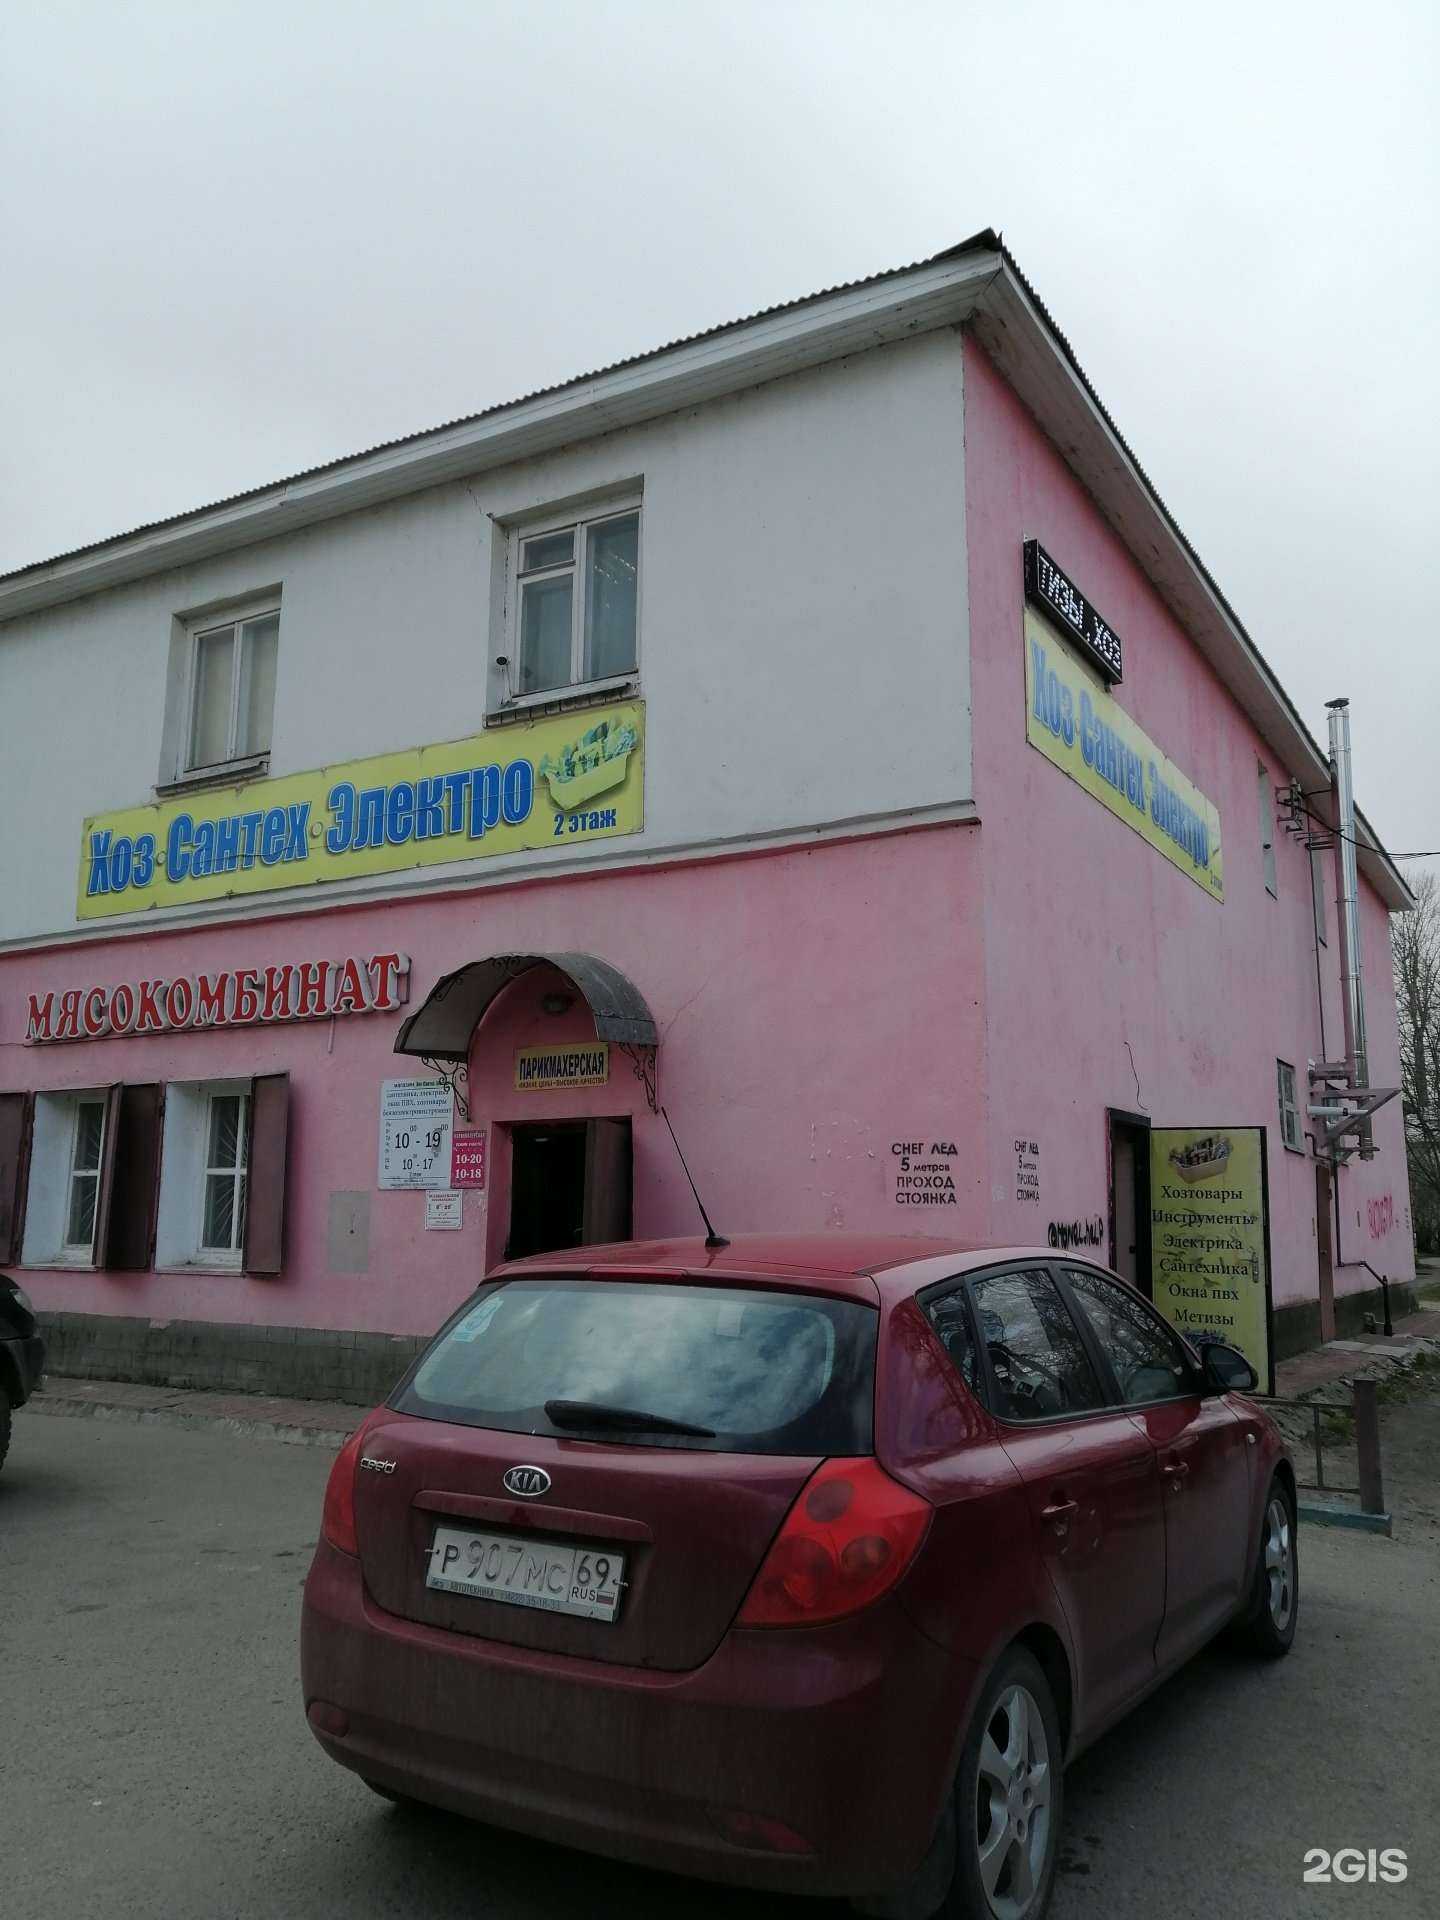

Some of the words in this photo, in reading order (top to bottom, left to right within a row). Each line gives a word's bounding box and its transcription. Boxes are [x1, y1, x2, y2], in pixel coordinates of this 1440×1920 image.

[1031, 638, 1075, 748] Хоз
[1079, 688, 1146, 815] Сантех
[86, 829, 157, 897] Хоз
[166, 801, 312, 884] Сантех
[325, 758, 534, 855] Электро
[553, 814, 566, 836] 2
[569, 809, 617, 833] этаж
[25, 953, 404, 1042] МЯСОКОМБИНАТ
[519, 1051, 605, 1081] ПАРИКМАХЕРСКАЯ
[395, 1132, 410, 1149] 10
[425, 1131, 441, 1149] 19
[891, 1142, 924, 1155] СНЕГ
[930, 1142, 959, 1156] ЛЕД
[402, 1158, 413, 1170] 10
[423, 1158, 434, 1170] 17
[455, 1153, 482, 1164] 10-20
[900, 1157, 910, 1172] 5
[913, 1163, 950, 1173] метров
[455, 1169, 482, 1179] 10-18
[896, 1175, 956, 1189] ПРОХОД
[896, 1192, 957, 1205] СТОЯНКА
[1160, 1185, 1243, 1203] Хозтовары
[1152, 1209, 1255, 1228] Инструменты
[1163, 1233, 1243, 1252] Электрика
[1159, 1258, 1249, 1276] Сантехника
[1168, 1283, 1207, 1300] Окна
[1211, 1288, 1240, 1301] пвх
[1175, 1308, 1234, 1326] Метизы
[509, 1469, 543, 1491] KIA
[576, 1553, 611, 1590] 69
[571, 1586, 597, 1601] RUS
